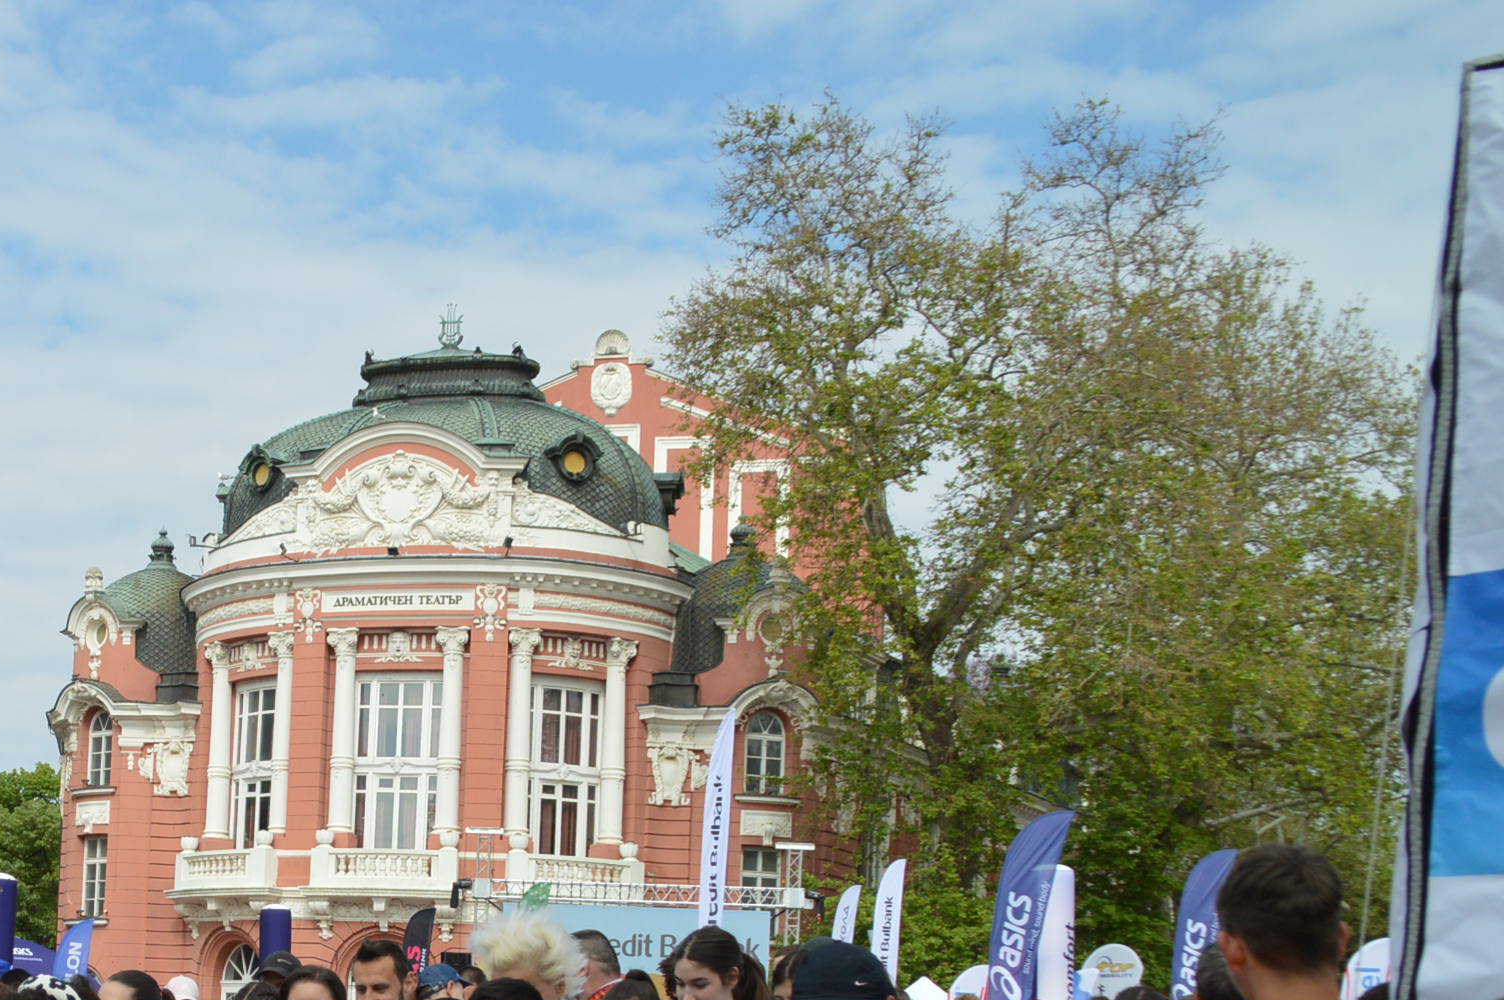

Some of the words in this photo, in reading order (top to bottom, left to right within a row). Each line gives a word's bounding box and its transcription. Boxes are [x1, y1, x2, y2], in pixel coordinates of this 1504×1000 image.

[333, 595, 414, 607] ДРАМАТИЧЕН
[418, 595, 463, 605] ТЕАТЪР
[880, 896, 894, 951] Bulbank
[614, 932, 654, 958] edit
